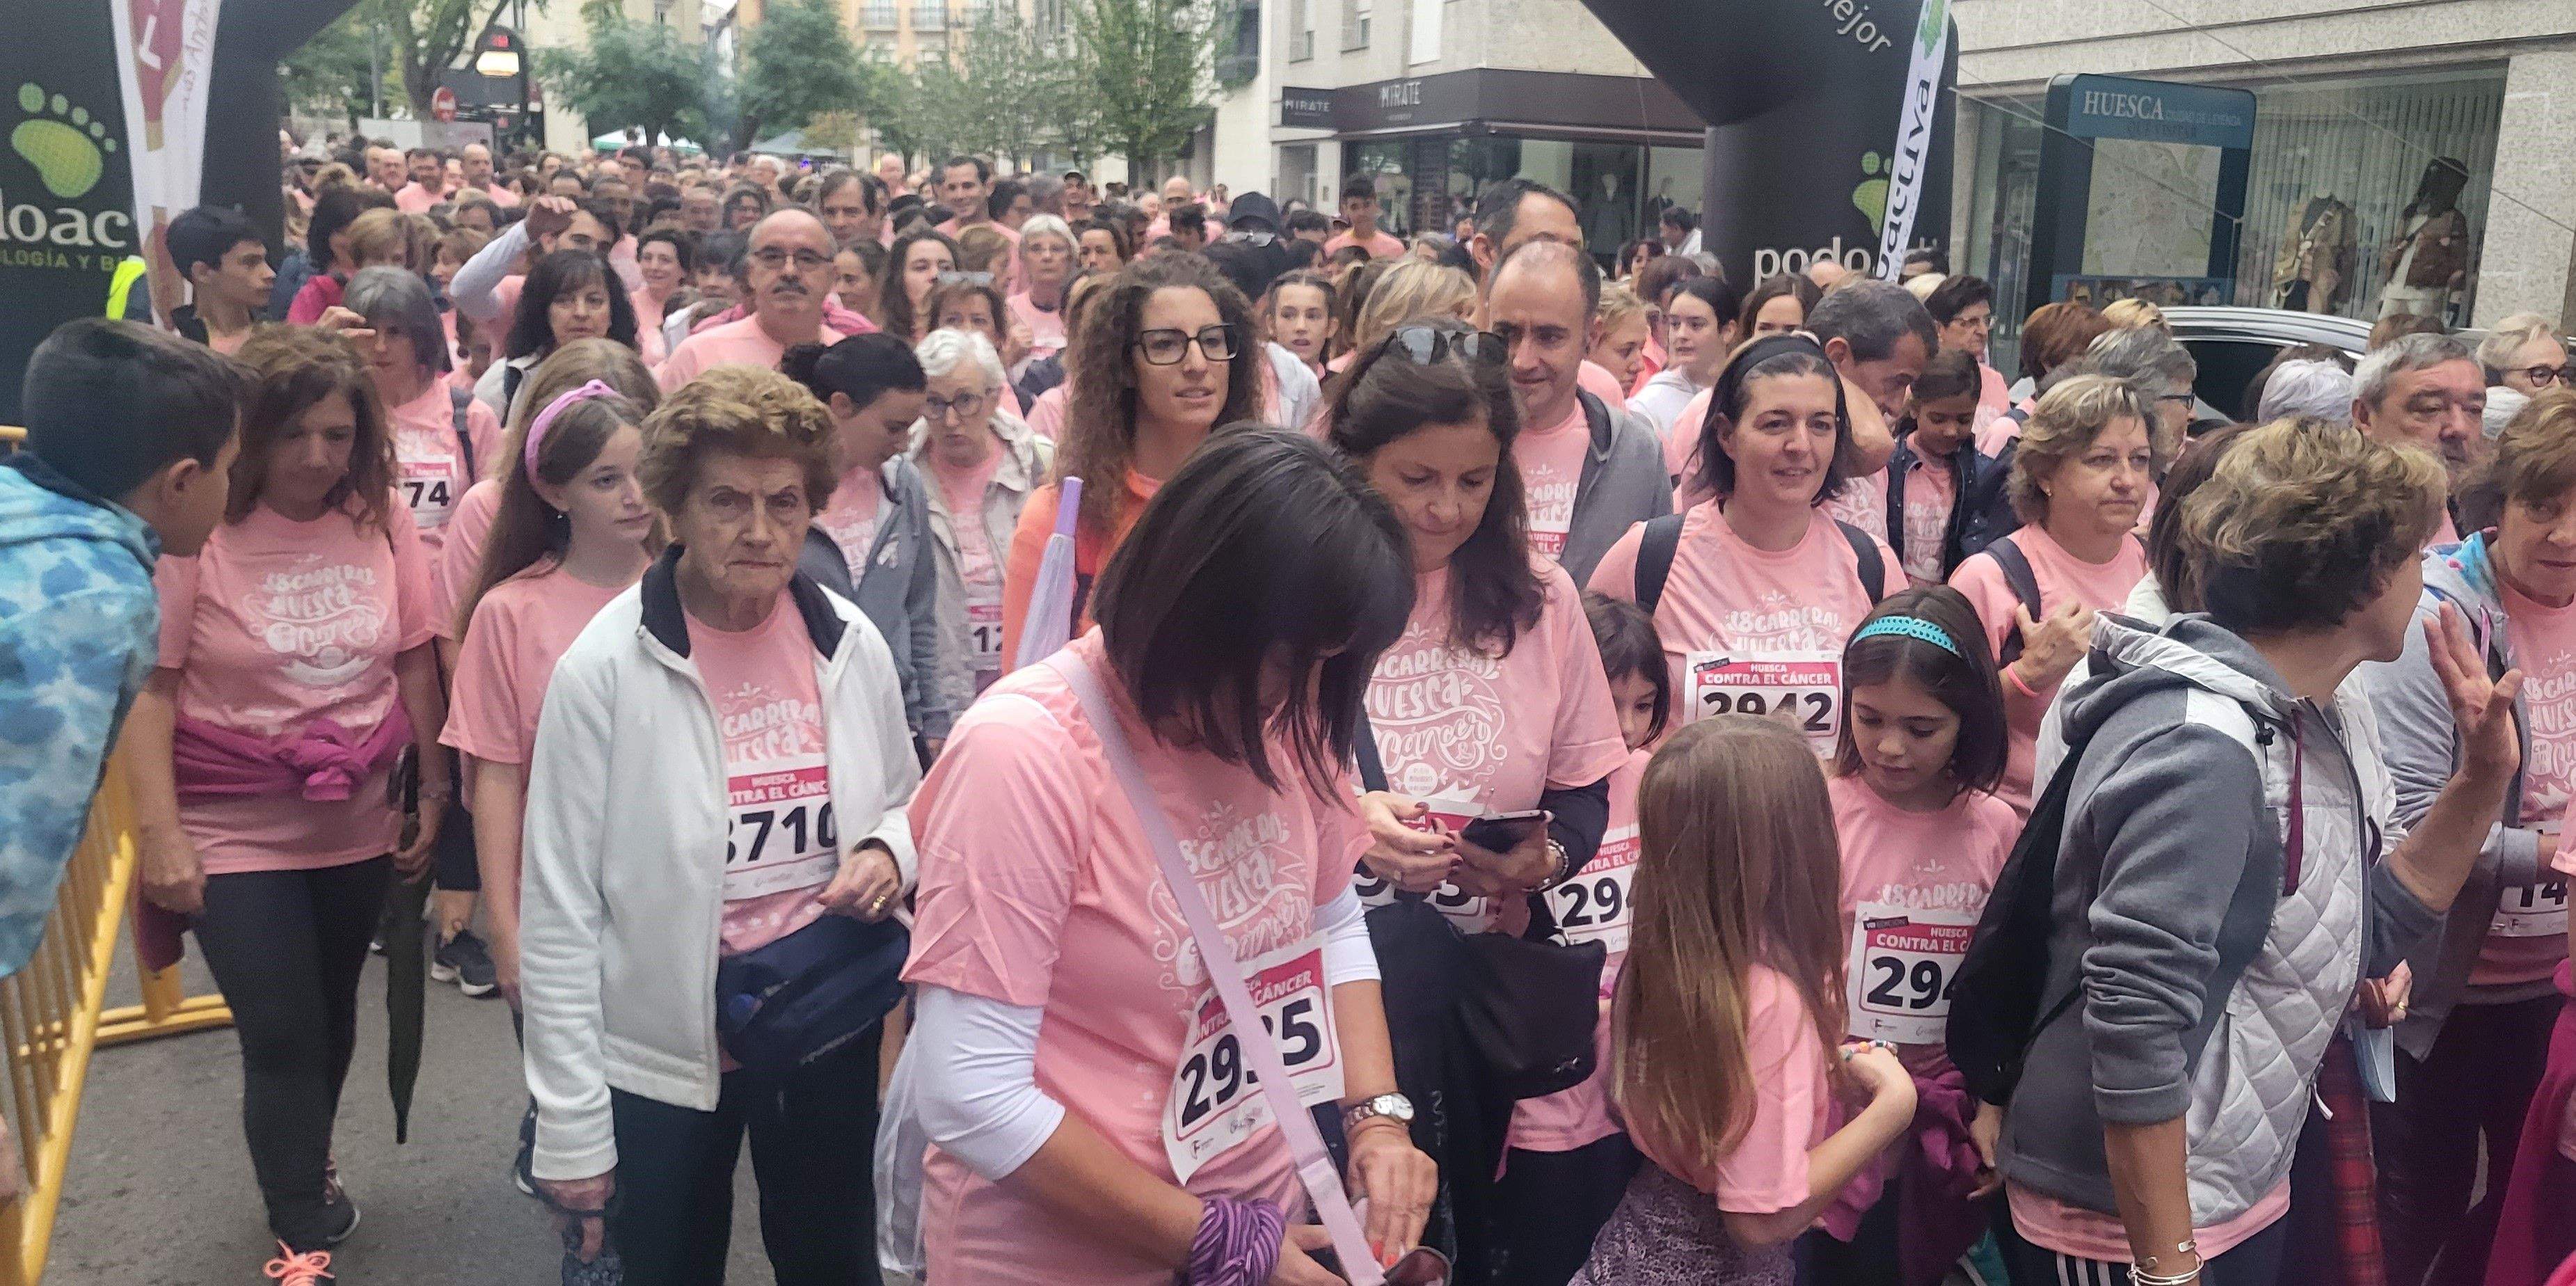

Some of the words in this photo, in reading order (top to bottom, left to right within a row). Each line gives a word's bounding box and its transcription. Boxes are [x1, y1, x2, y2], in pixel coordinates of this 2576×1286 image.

[1822, 0, 1893, 53] ejor
[2083, 90, 2164, 120] HUESCA
[402, 481, 451, 508] 74
[1533, 534, 1560, 542] UESCA
[1705, 674, 1760, 685] CONTRA
[1763, 675, 1779, 684] EL
[1781, 670, 1832, 685] CÁNCER
[1750, 664, 1788, 673] HUESCA
[1703, 692, 1833, 731] 2942
[768, 786, 788, 800] EL
[1612, 854, 1625, 866] EL
[1558, 878, 1630, 928] 29
[1876, 933, 1939, 951] CONTRA
[1943, 940, 1955, 952] EL
[1930, 927, 1968, 937] HUESCA
[1255, 970, 1312, 1006] CÁNCER
[1867, 956, 1951, 1010] 29
[1180, 997, 1321, 1128] 295
